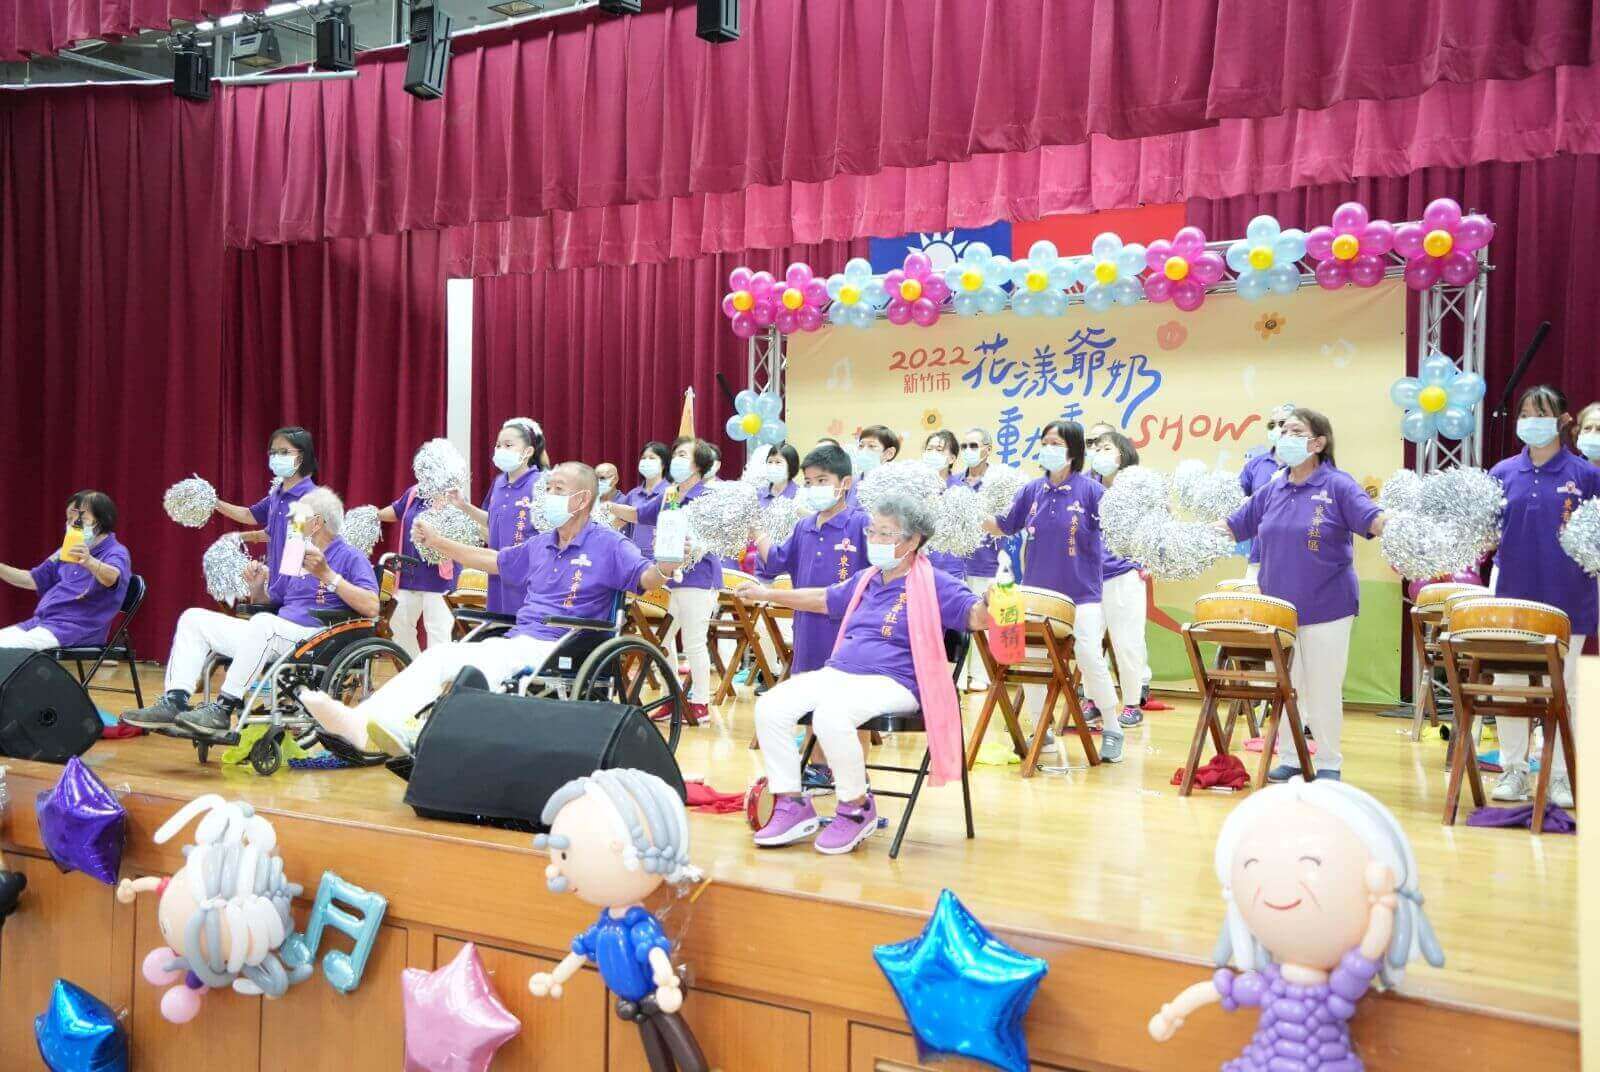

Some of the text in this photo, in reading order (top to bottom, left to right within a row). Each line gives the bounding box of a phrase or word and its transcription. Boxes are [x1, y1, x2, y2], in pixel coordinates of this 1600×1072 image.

[889, 346, 971, 371] 2022
[903, 371, 951, 394] 新竹市
[961, 328, 1162, 430] 花漾爺奶
[1131, 414, 1262, 452] SHOW
